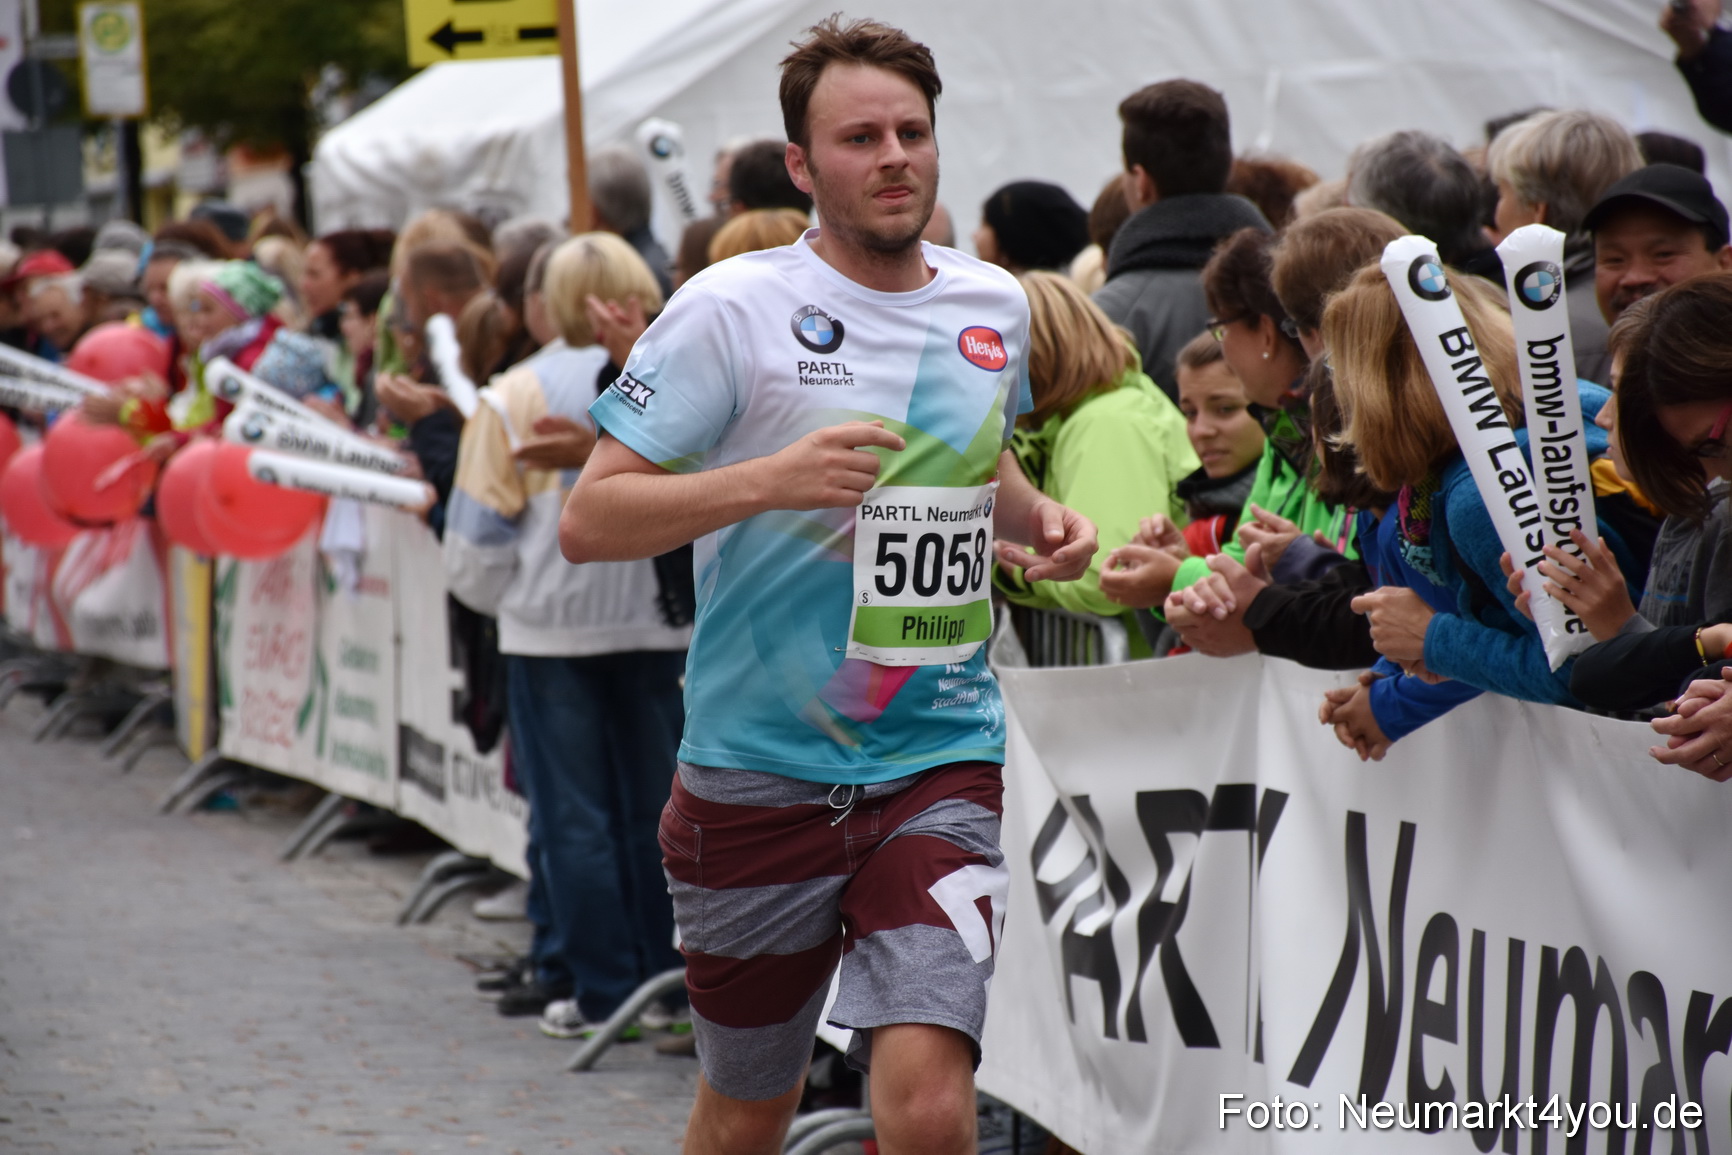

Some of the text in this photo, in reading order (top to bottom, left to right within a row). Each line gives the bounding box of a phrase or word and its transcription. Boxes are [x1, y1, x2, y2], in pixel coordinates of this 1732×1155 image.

[792, 306, 836, 323] BMW
[964, 335, 1004, 360] Hervis
[797, 360, 853, 376] PARTL
[799, 375, 855, 386] Neumarkt
[1438, 326, 1510, 431] BMW
[1526, 333, 1589, 634] bmw-laufspoe
[861, 504, 982, 522] PARTL Neumarkt
[874, 527, 987, 597] 5058
[901, 615, 965, 645] Philipp
